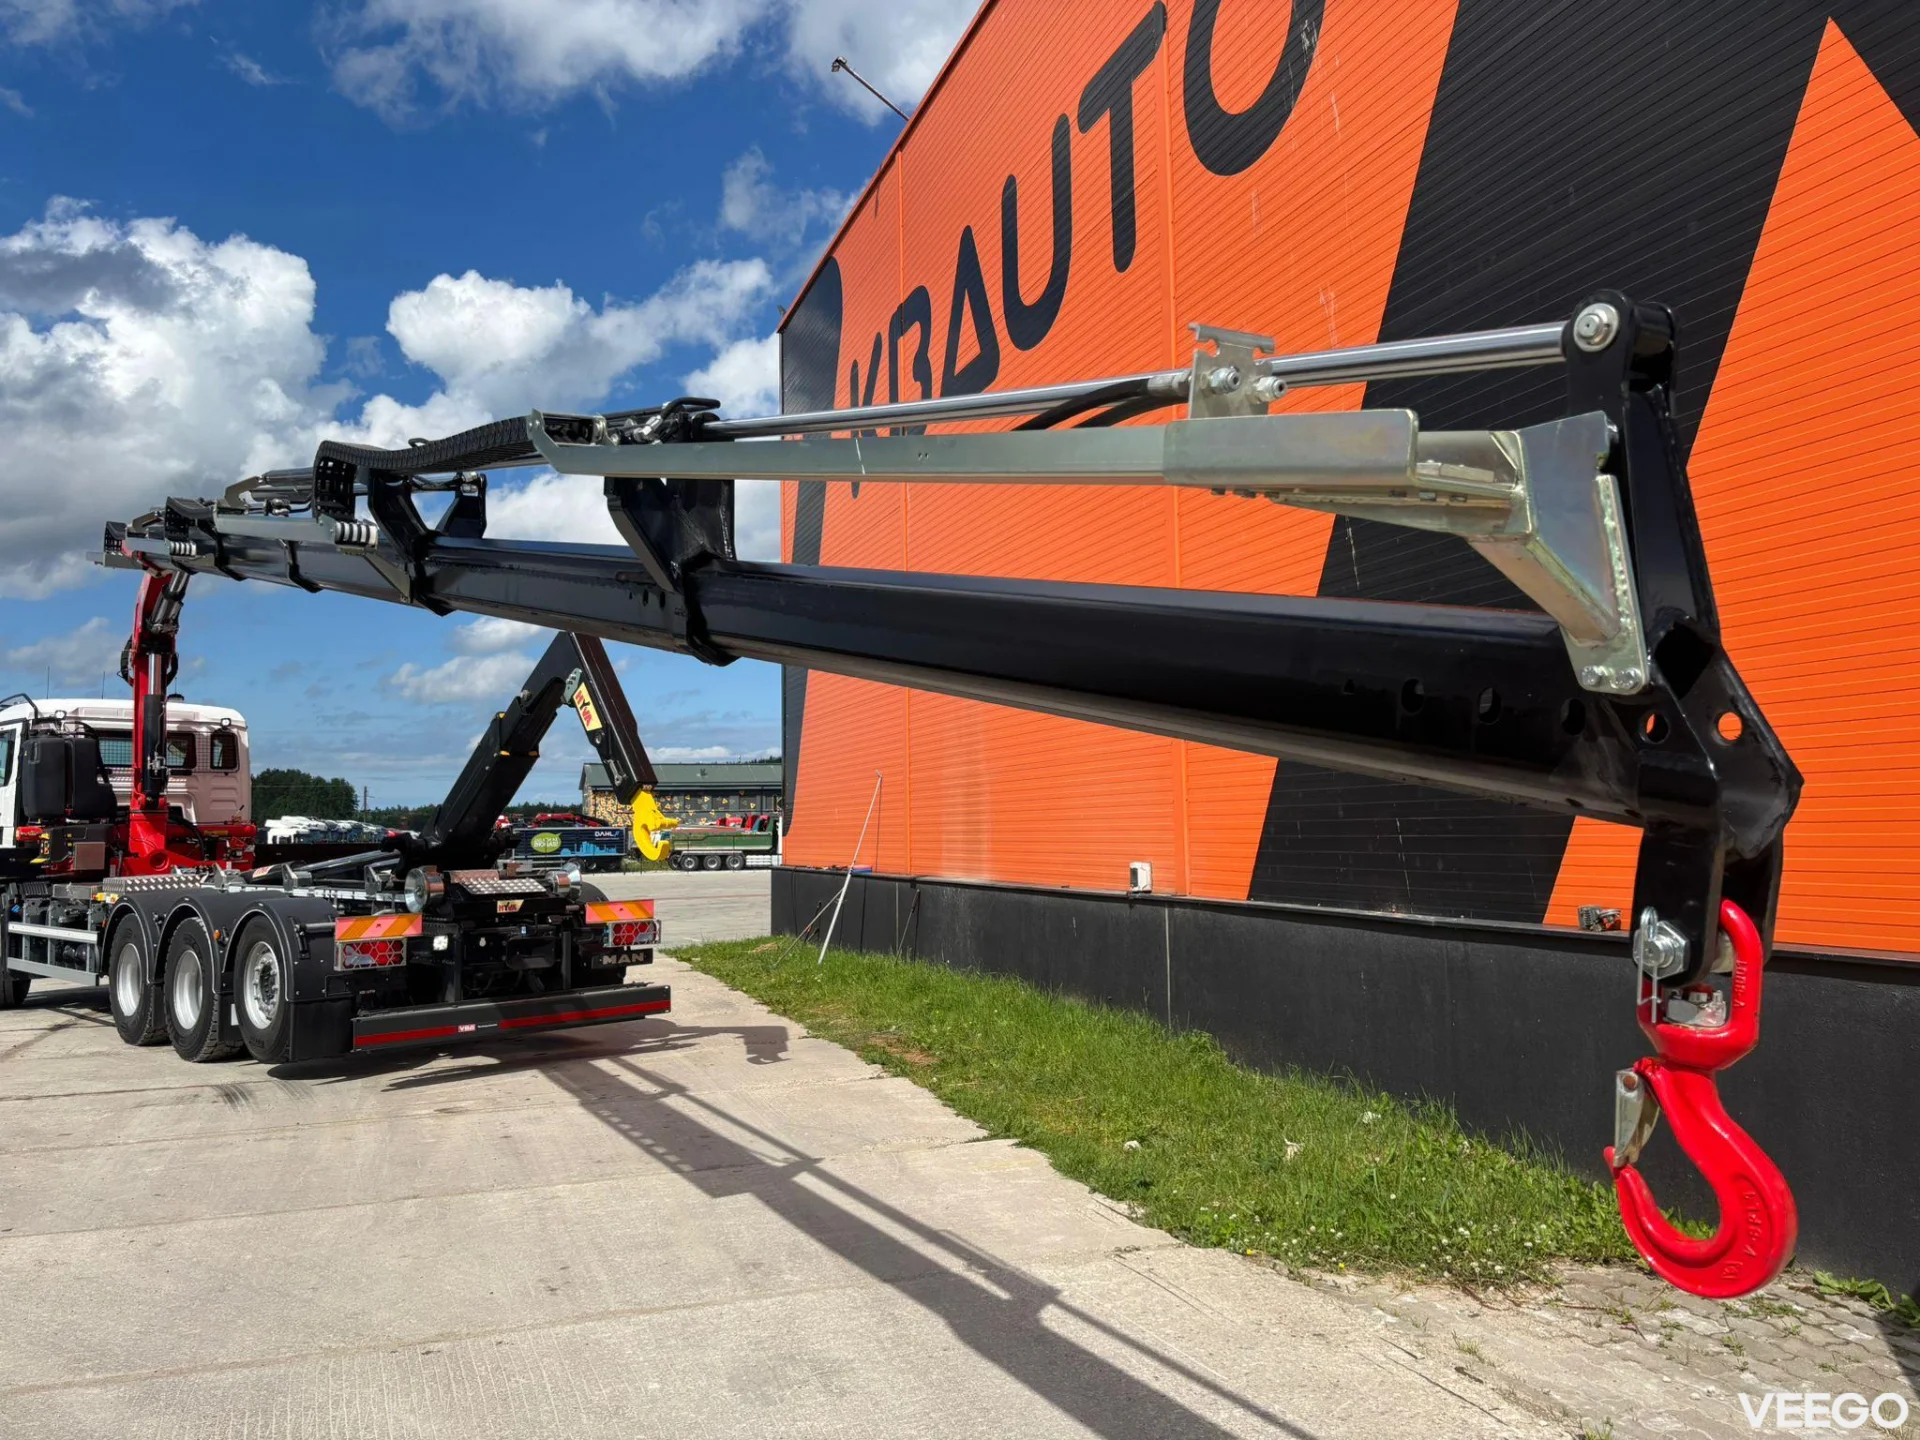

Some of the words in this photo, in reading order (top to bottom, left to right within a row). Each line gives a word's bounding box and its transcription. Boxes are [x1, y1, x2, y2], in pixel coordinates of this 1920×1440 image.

[575, 690, 592, 727] HYVA
[499, 902, 517, 911] HYVA
[602, 952, 644, 965] MAN
